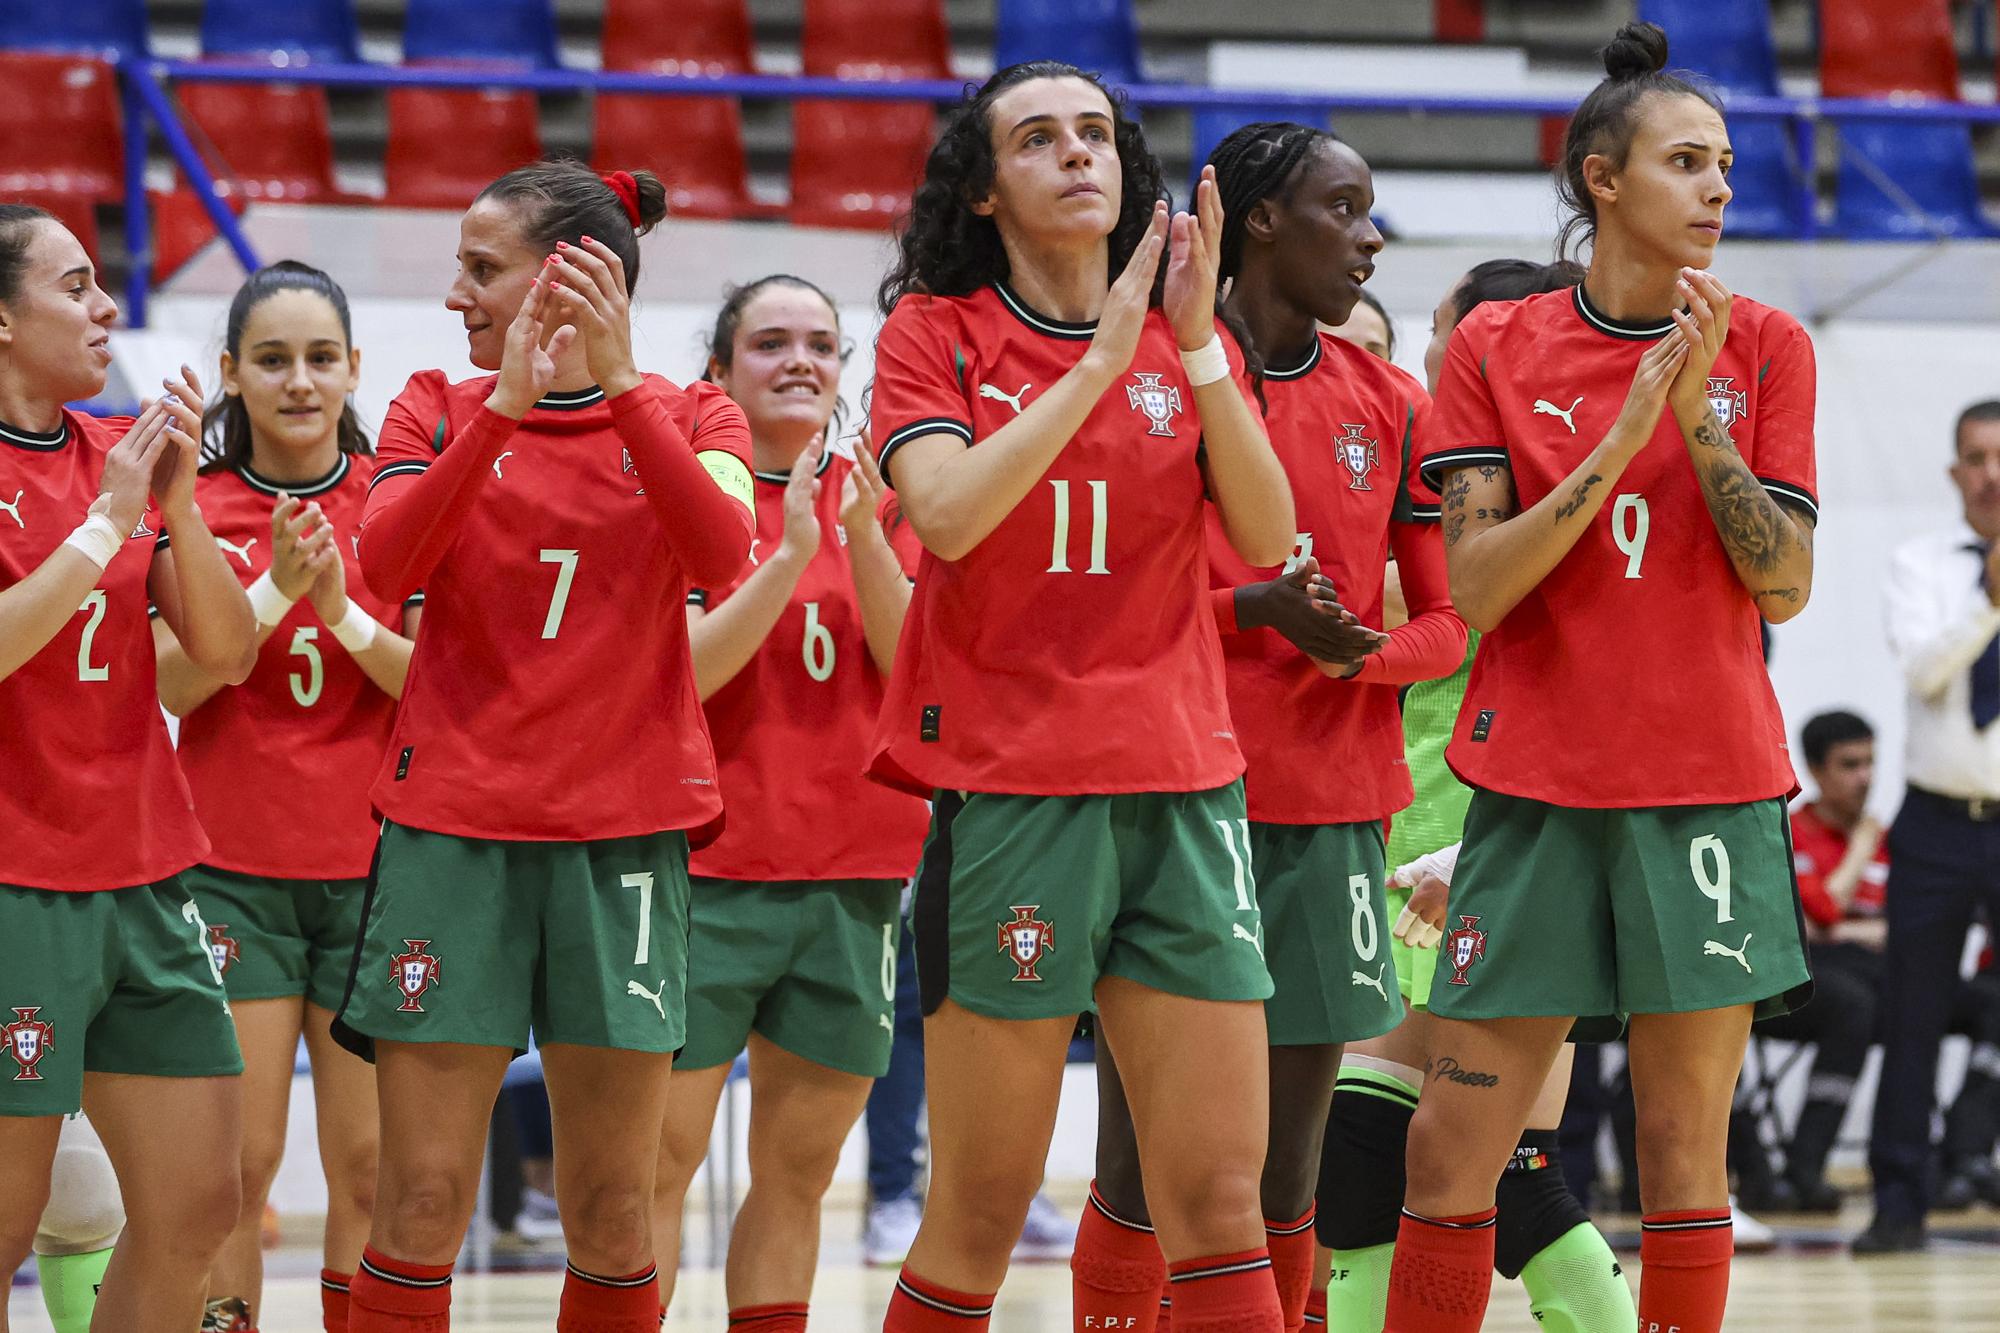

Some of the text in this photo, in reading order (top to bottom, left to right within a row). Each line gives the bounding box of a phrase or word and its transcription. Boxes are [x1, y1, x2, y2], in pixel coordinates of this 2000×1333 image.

[1047, 481, 1110, 573] 11
[1612, 493, 1650, 579] 9
[78, 589, 109, 681] 2
[539, 549, 580, 640] 7
[289, 626, 324, 707] 5
[803, 602, 836, 682] 6
[1215, 818, 1260, 912] 11
[1689, 833, 1735, 924] 9
[620, 871, 654, 966] 7
[881, 923, 897, 1002] 6
[1348, 873, 1378, 962] 8
